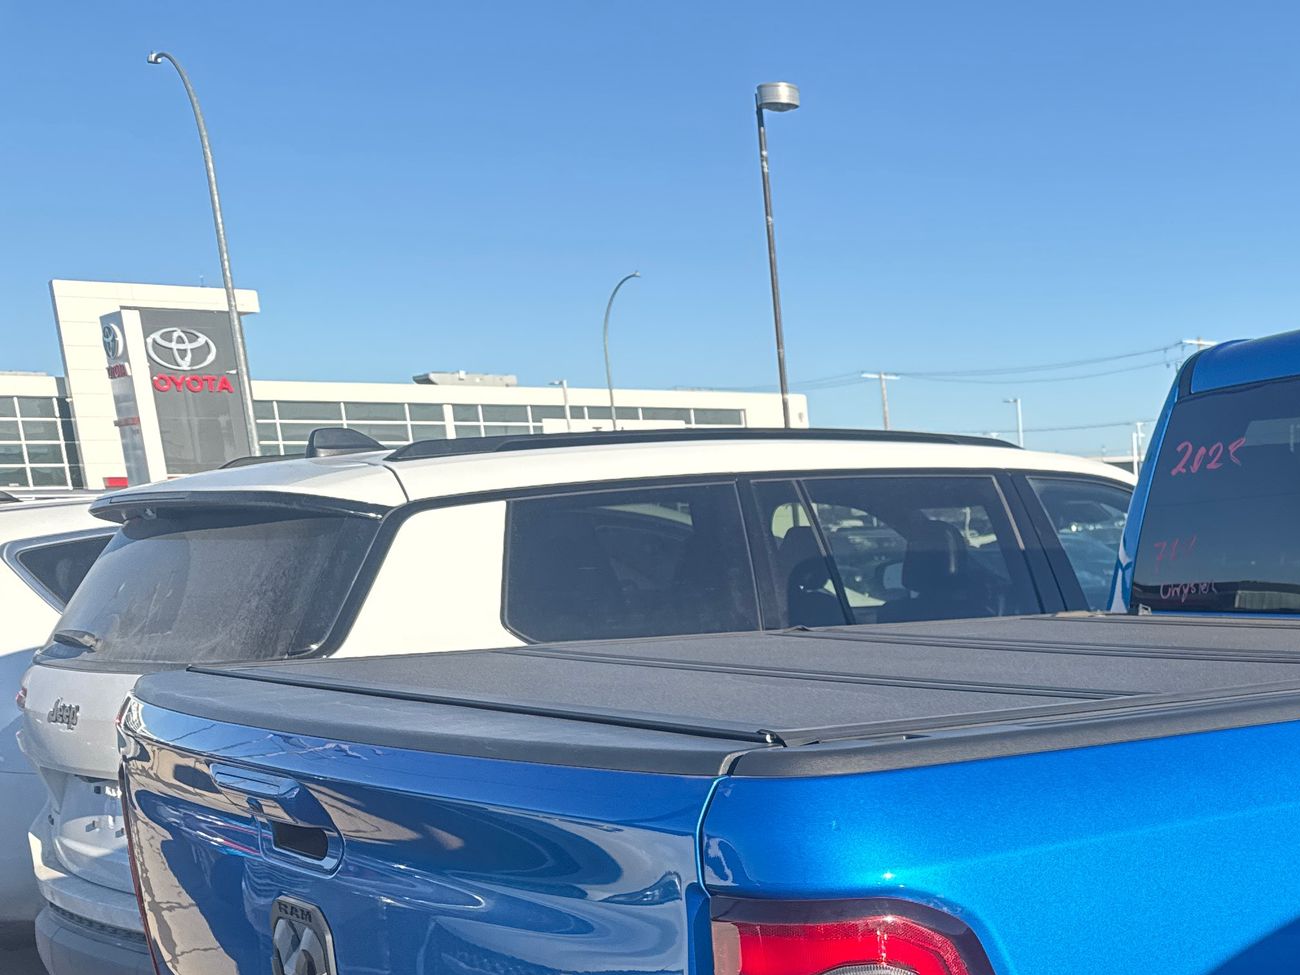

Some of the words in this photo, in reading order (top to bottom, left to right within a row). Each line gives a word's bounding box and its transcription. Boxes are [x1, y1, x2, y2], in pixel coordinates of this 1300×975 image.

[152, 374, 235, 393] OYOTA
[48, 696, 80, 730] Jeep
[278, 903, 313, 922] RAM
